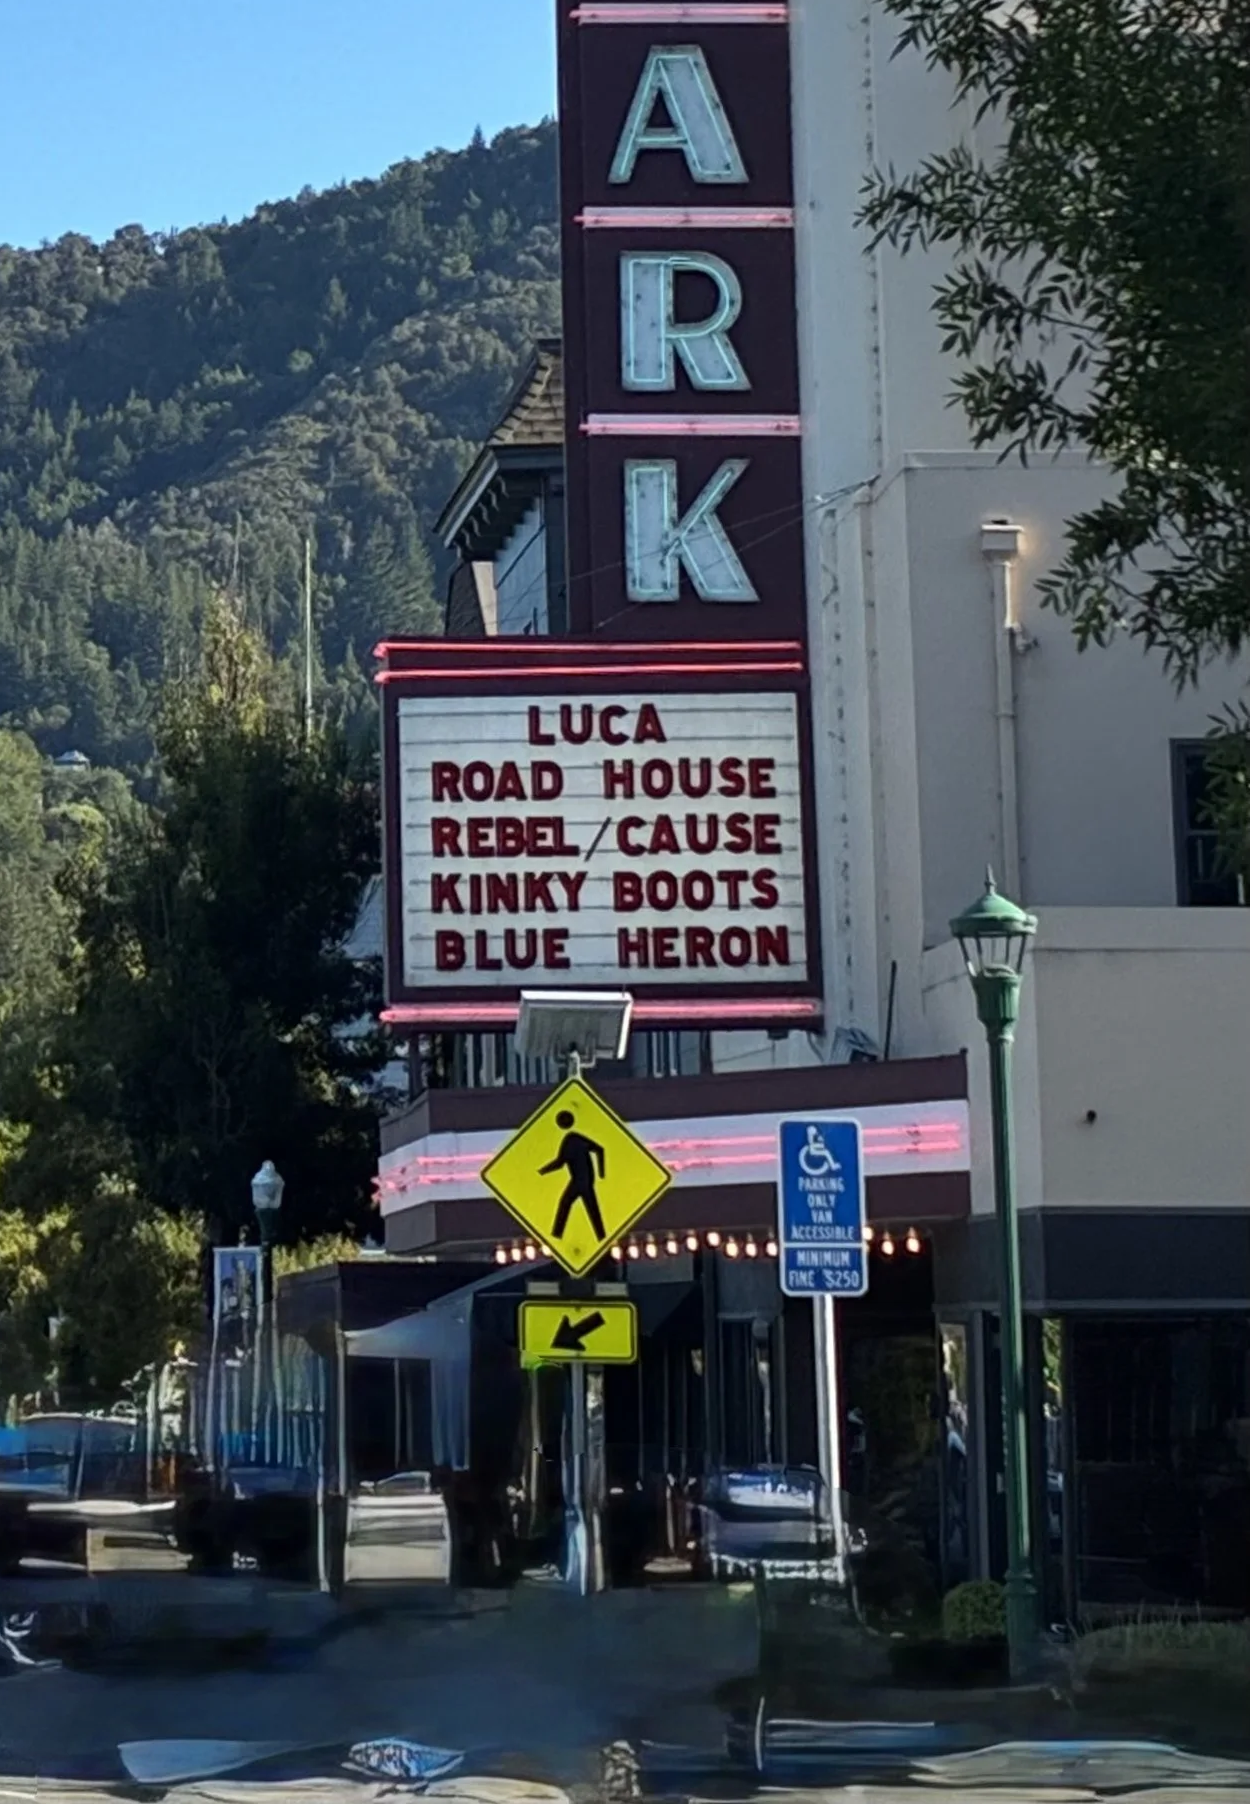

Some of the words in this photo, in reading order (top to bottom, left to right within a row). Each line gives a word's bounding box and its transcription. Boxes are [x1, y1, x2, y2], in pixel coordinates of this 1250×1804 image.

[528, 703, 666, 745] LUCA
[431, 761, 563, 802] ROAD
[603, 758, 776, 798] HOUSE
[431, 871, 587, 915] KINKY
[613, 868, 779, 911] BOOTS
[435, 927, 570, 971] BLUE
[617, 925, 790, 968] HERON
[798, 1177, 844, 1192] PARKING
[807, 1194, 835, 1207] ONLY
[811, 1210, 833, 1223] VAN
[791, 1225, 854, 1240] ACCESSIBLE
[797, 1251, 850, 1266] MINIMUM
[788, 1270, 815, 1287] FINE
